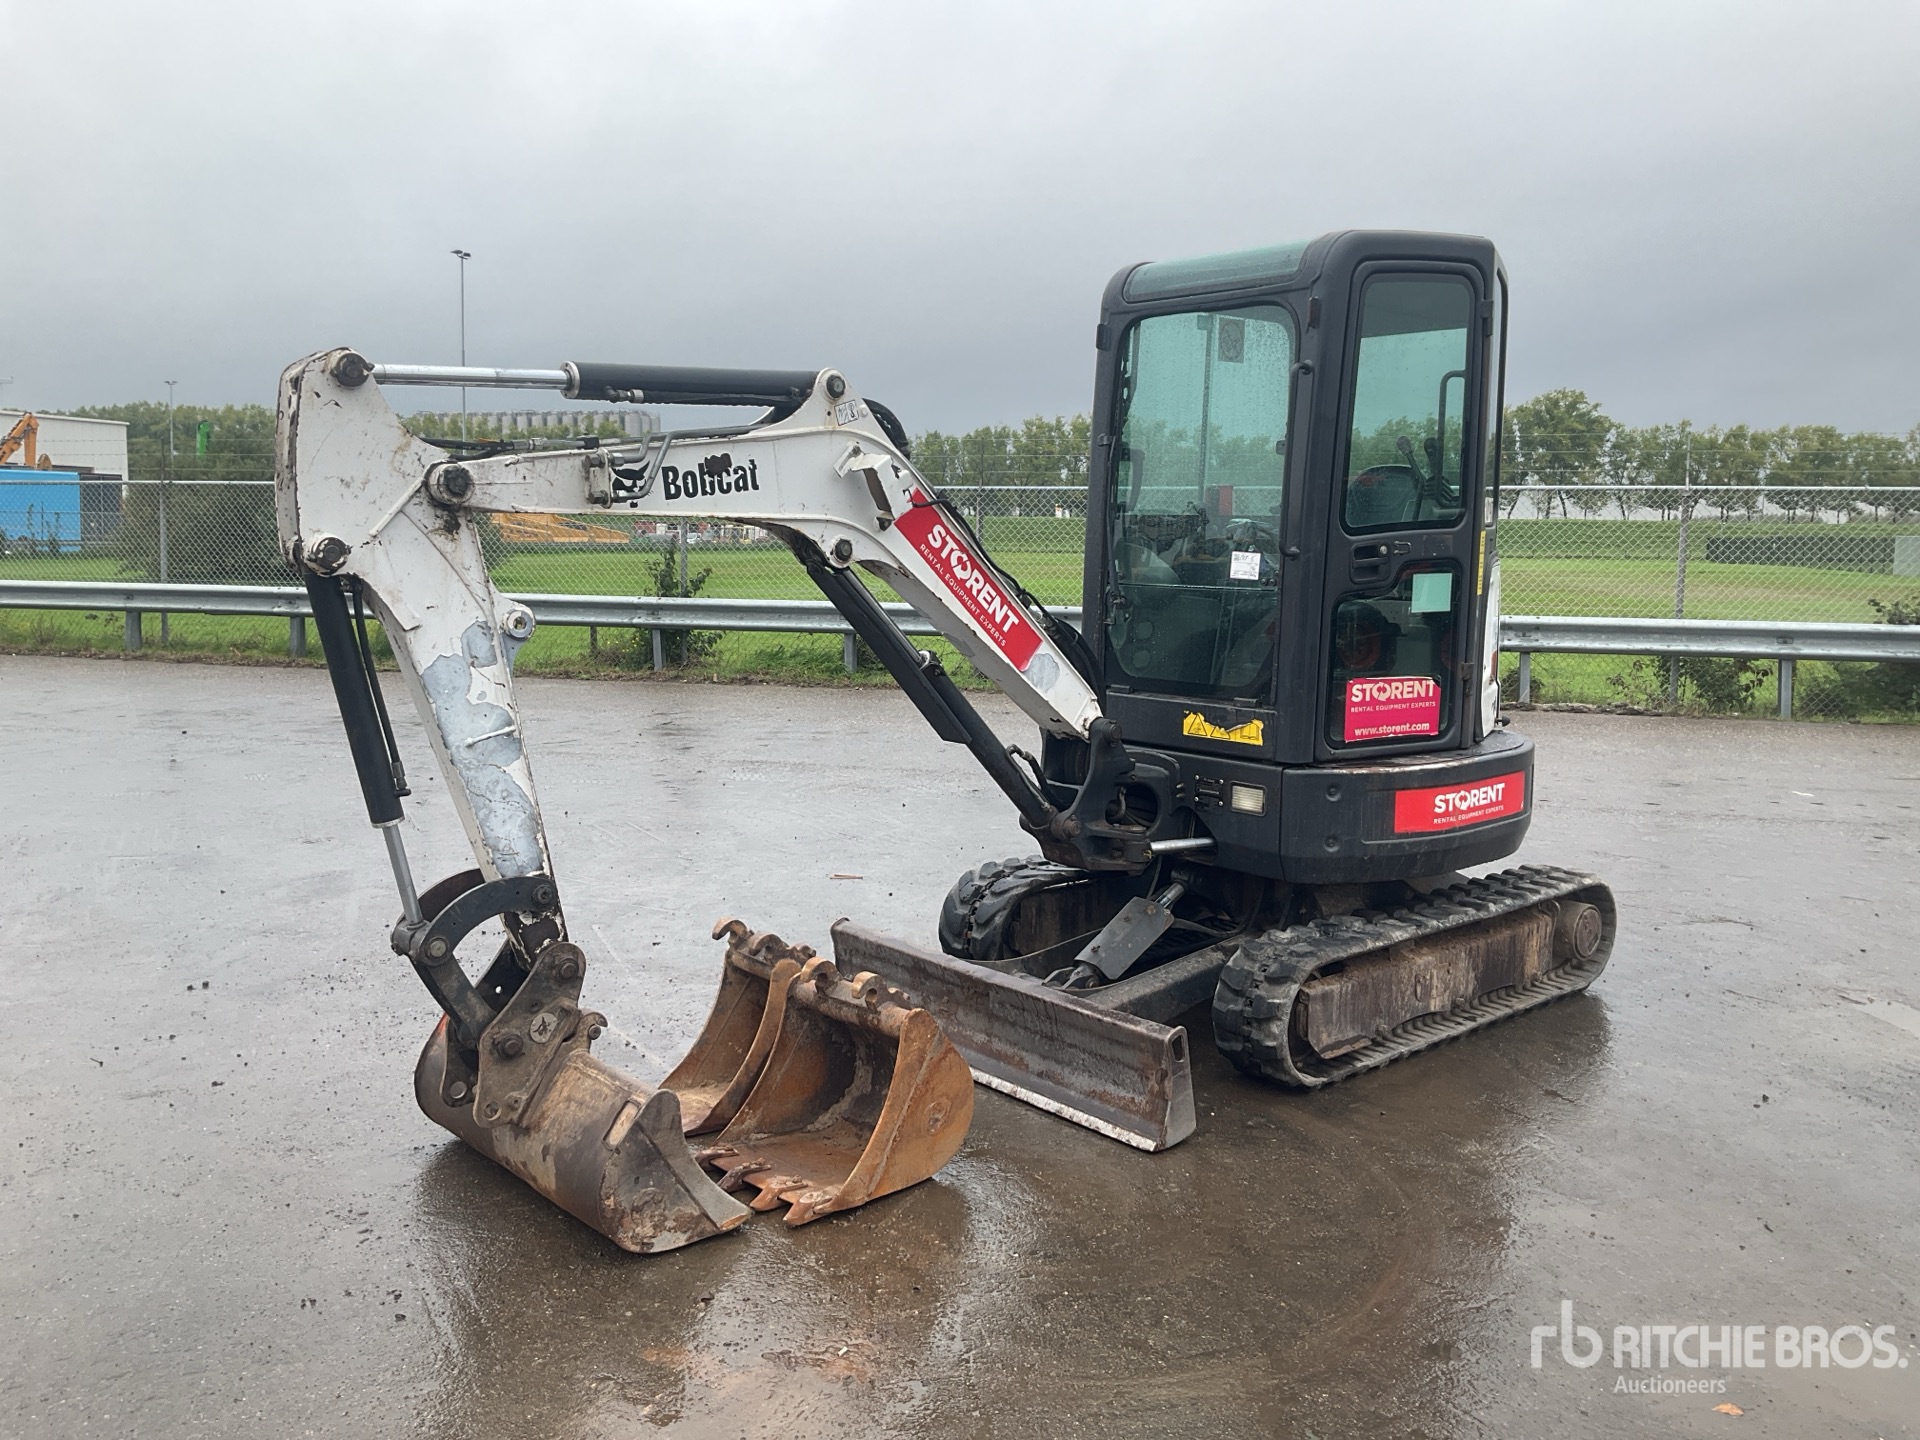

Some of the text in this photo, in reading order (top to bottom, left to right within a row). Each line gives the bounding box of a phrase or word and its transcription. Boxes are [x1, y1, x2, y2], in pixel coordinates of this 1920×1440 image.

[661, 458, 760, 500] Bobcat
[926, 524, 1020, 633] STORENT
[919, 543, 1007, 647] RENTAL EQUIPMENT EXPERTS
[1351, 680, 1436, 702] STORENT
[1375, 703, 1410, 711] EQUIPMENT
[1354, 723, 1430, 736] www.storent.com
[1433, 783, 1506, 813] STORENT
[1433, 805, 1505, 824] RENTAL EQUIPMENT EXPERTS
